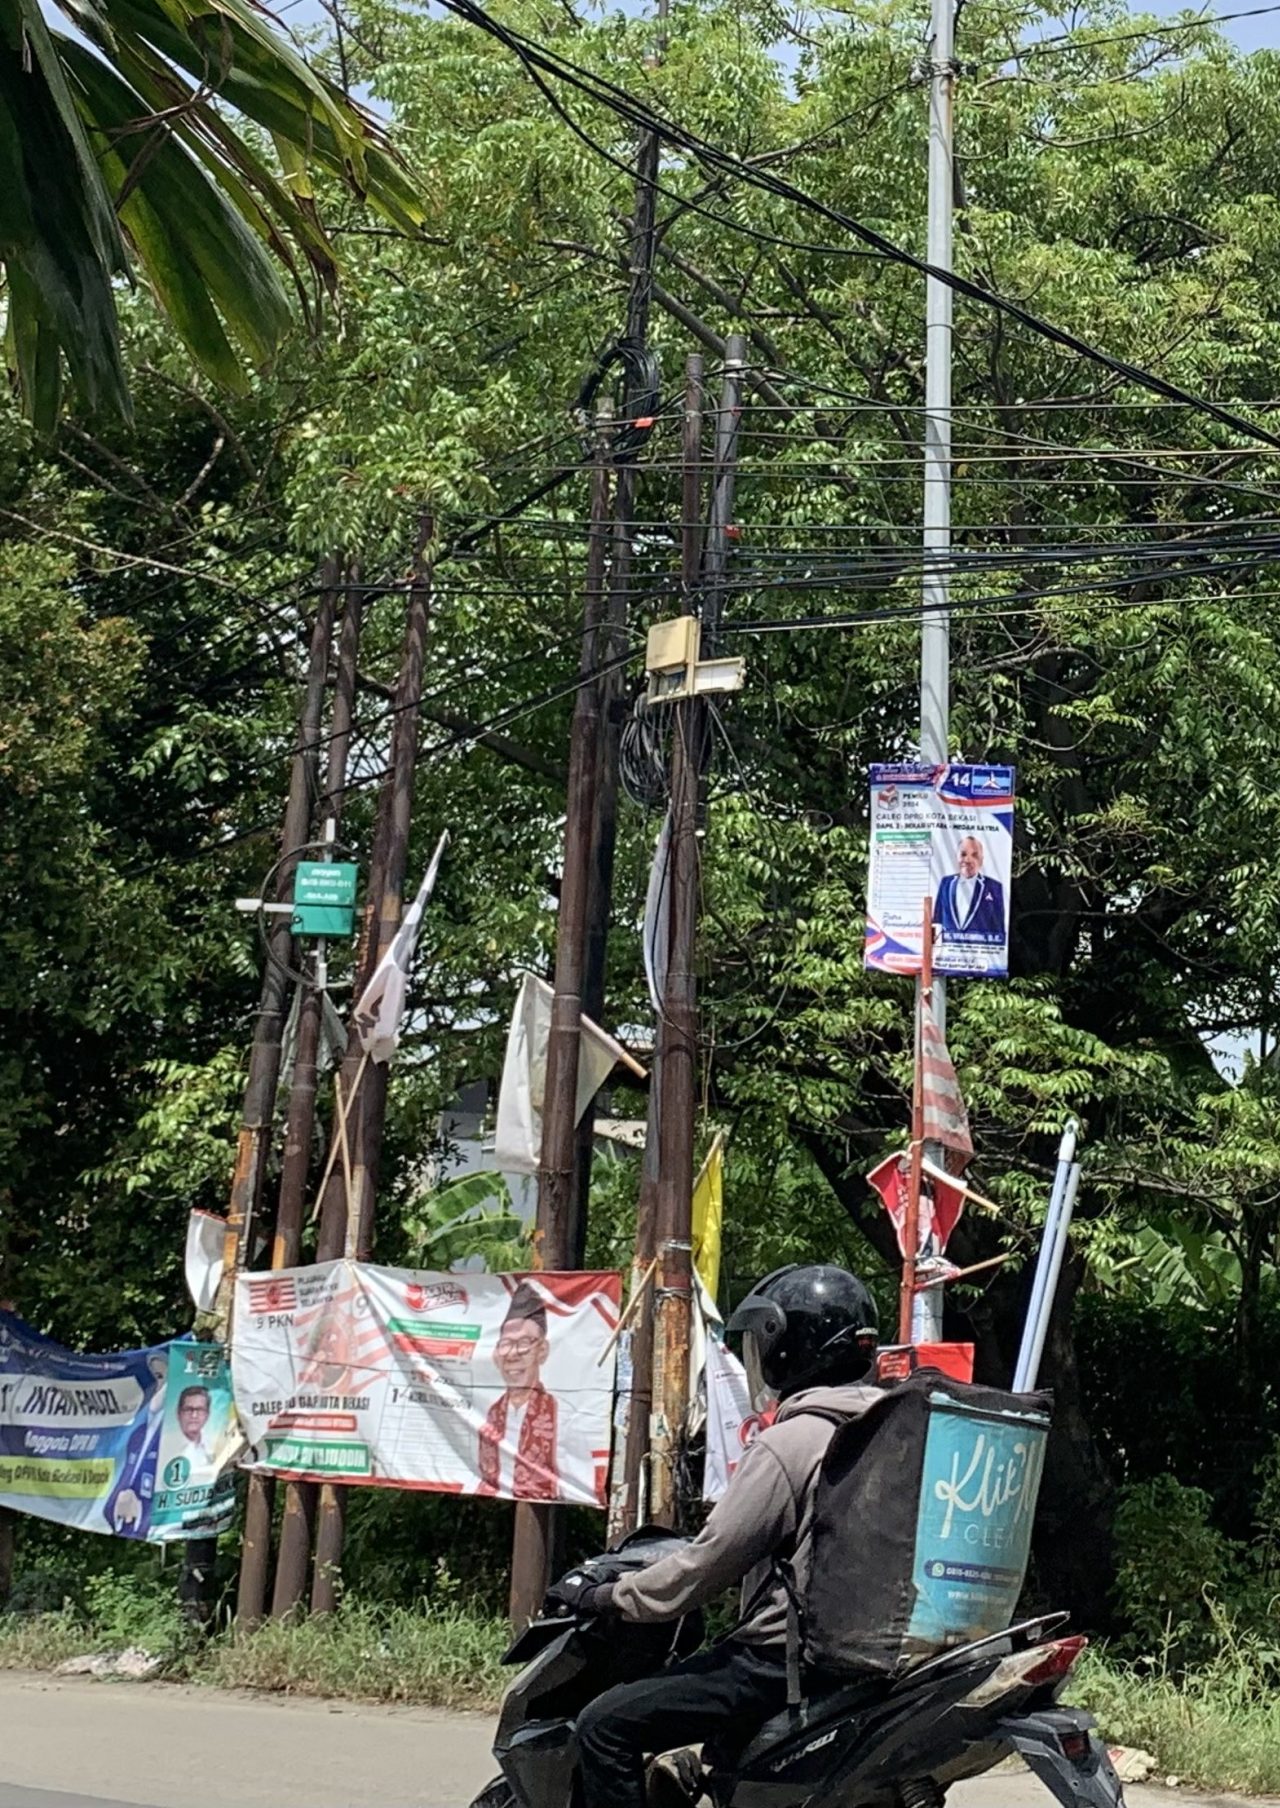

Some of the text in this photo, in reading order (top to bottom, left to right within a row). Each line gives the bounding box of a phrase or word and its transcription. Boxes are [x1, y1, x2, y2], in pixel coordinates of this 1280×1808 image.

[951, 772, 971, 787] 14
[876, 813, 902, 821] CALEG
[256, 1314, 294, 1328] 9 PKN
[22, 1386, 121, 1417] INTAN FAUZI
[174, 1464, 182, 1483] 1
[158, 1493, 170, 1509] H.
